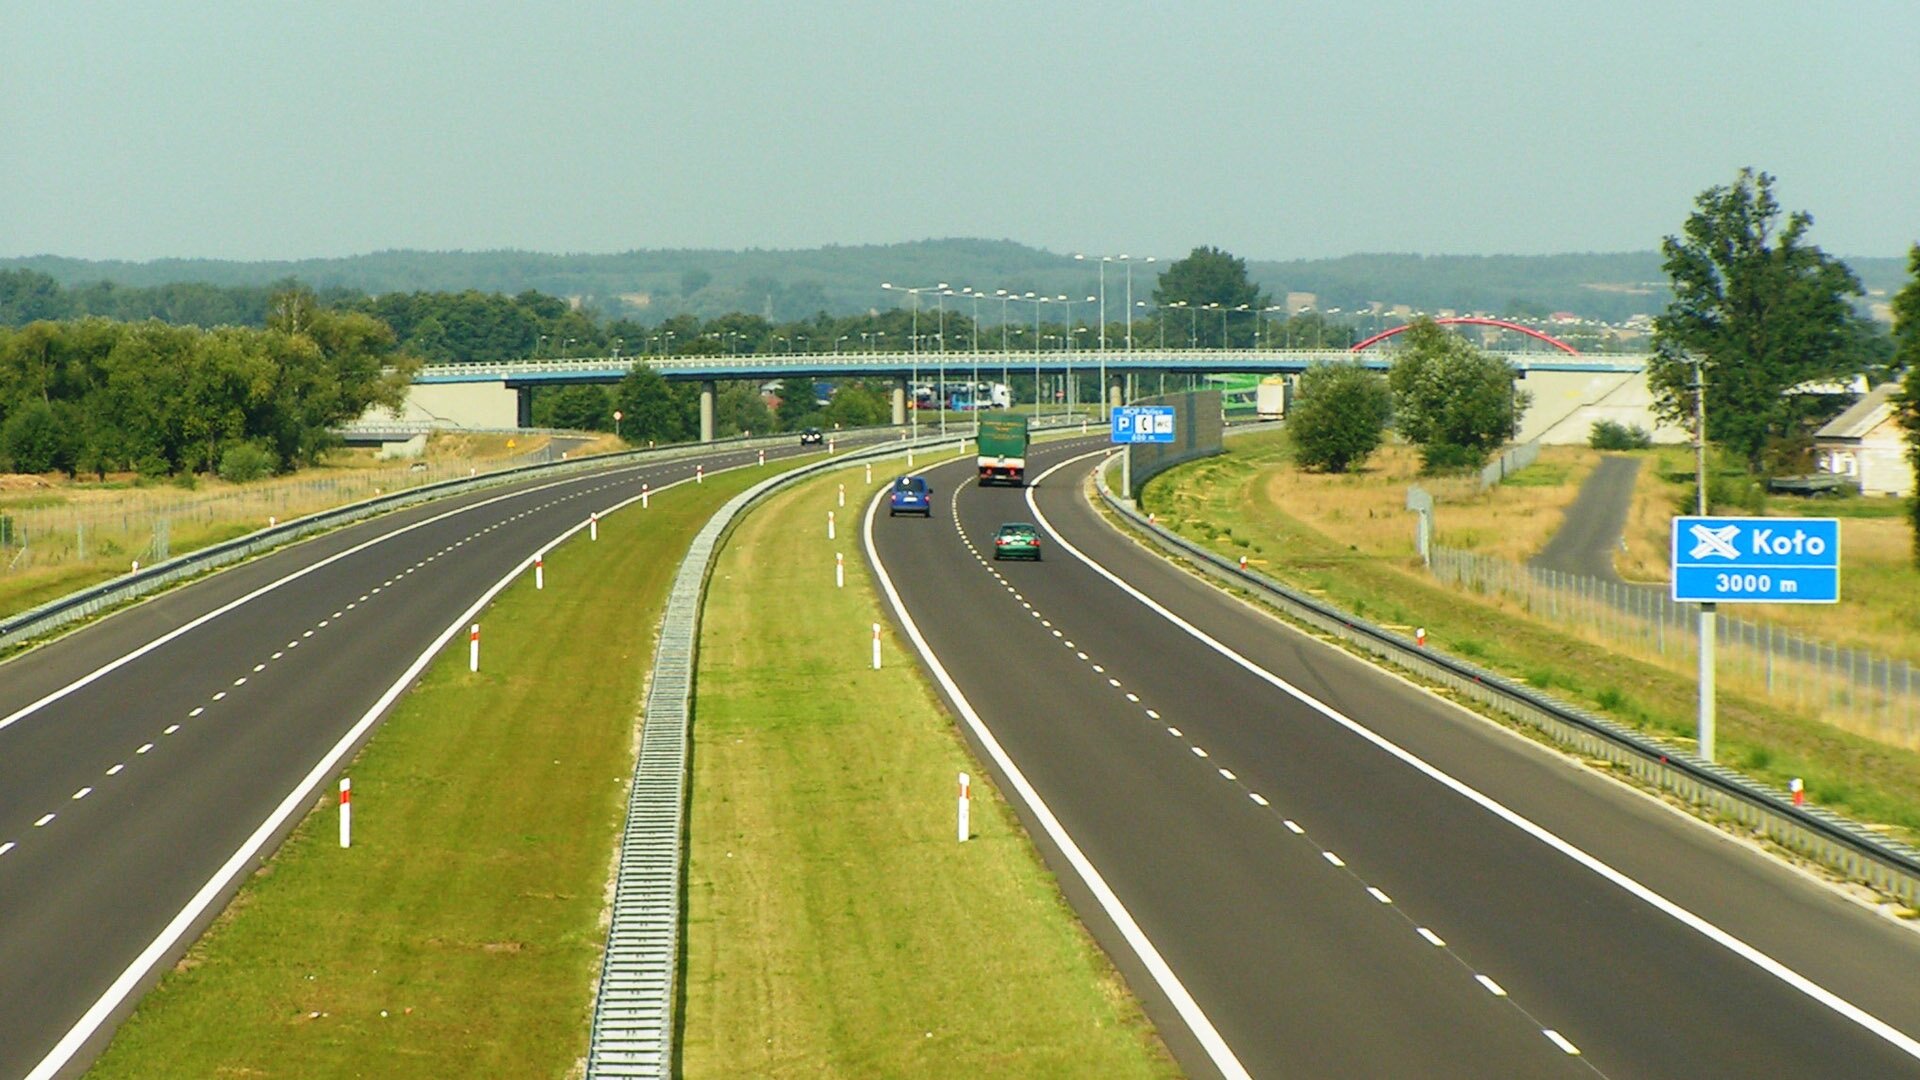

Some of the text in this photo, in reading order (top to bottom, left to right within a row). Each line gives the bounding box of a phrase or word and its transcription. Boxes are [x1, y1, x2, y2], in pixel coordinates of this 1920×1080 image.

[1118, 417, 1170, 432] P WC
[1752, 529, 1825, 555] Koło
[1716, 573, 1798, 592] 3000 m
